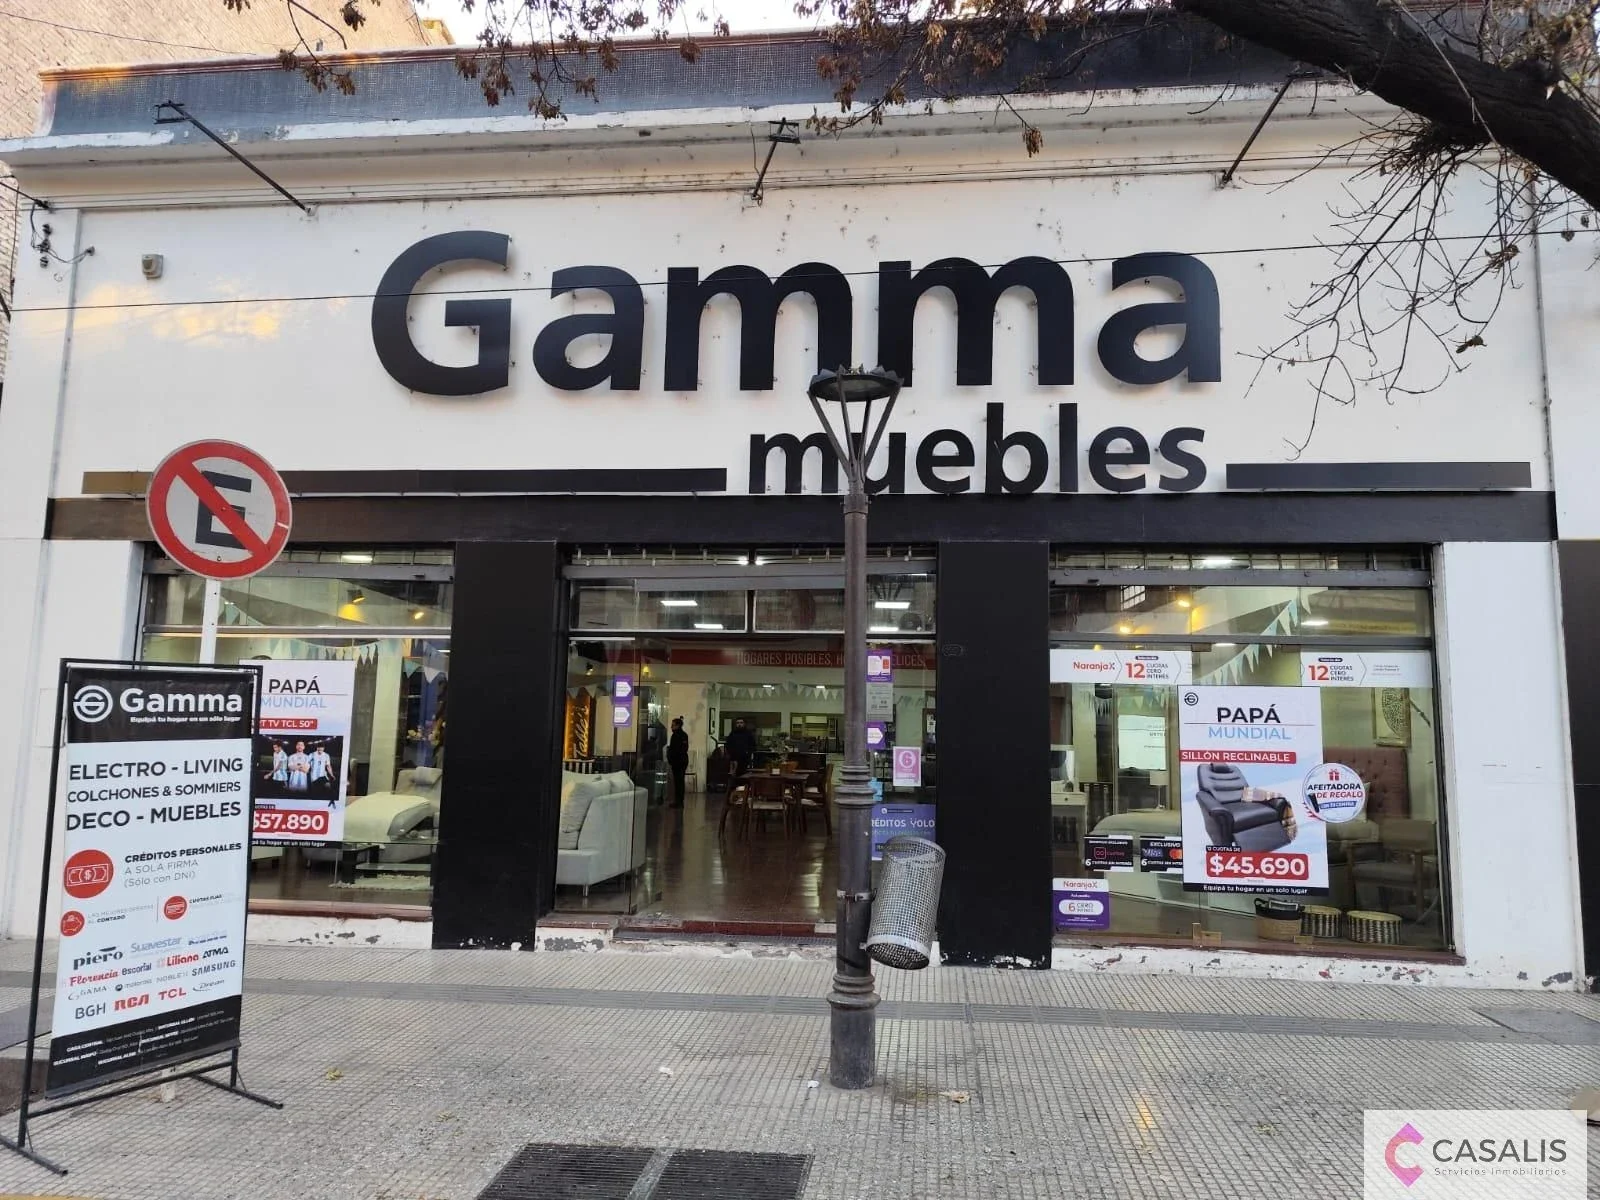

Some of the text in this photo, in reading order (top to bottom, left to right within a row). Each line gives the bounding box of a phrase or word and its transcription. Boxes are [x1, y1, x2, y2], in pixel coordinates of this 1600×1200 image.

[371, 229, 1221, 396] Gamma
[748, 402, 1207, 495] muebles
[736, 652, 782, 665] HOGARES
[784, 652, 833, 667] POSIBLES,
[1126, 663, 1146, 679] 12
[1308, 664, 1330, 681] 12
[269, 675, 320, 694] PAPÁ
[120, 687, 243, 713] Gamma
[261, 696, 328, 709] MUNDIAL
[1216, 703, 1281, 723] PAPÁ
[269, 719, 280, 728] TV
[282, 719, 298, 728] TCL
[1208, 726, 1293, 740] MUNDIAL
[1182, 750, 1290, 762] SILLÓN RECLINABLE
[69, 761, 166, 781] ELECTRO
[184, 757, 243, 775] LIVING
[67, 781, 241, 803] COLCHONES & SOMMIERS
[1307, 783, 1361, 791] AFEITADORA
[1330, 790, 1364, 799] REGALO
[66, 810, 131, 831] DECO
[150, 801, 242, 824] MUEBLES
[254, 813, 324, 831] $57.890
[872, 817, 907, 828] ÉDITOS
[124, 851, 178, 863] CRÉDITOS
[180, 842, 242, 857] PERSONALES
[1141, 848, 1163, 857] VISA
[124, 859, 199, 875] A SOLA FIRMA
[1085, 858, 1092, 867] 6
[1141, 858, 1148, 867] 6
[1210, 853, 1305, 876] $45.690
[153, 875, 171, 885] con
[1203, 884, 1226, 892] Equipá
[1235, 885, 1255, 893] hogar
[1068, 902, 1076, 912] 6
[73, 946, 124, 970] piero
[130, 937, 182, 953] Suavestar
[69, 969, 120, 987] Florencia
[166, 953, 199, 967] Liliana
[202, 946, 229, 959] ATMA
[191, 959, 236, 976] SAMSUNG
[75, 1001, 106, 1020] BGH
[158, 987, 187, 1002] TCL
